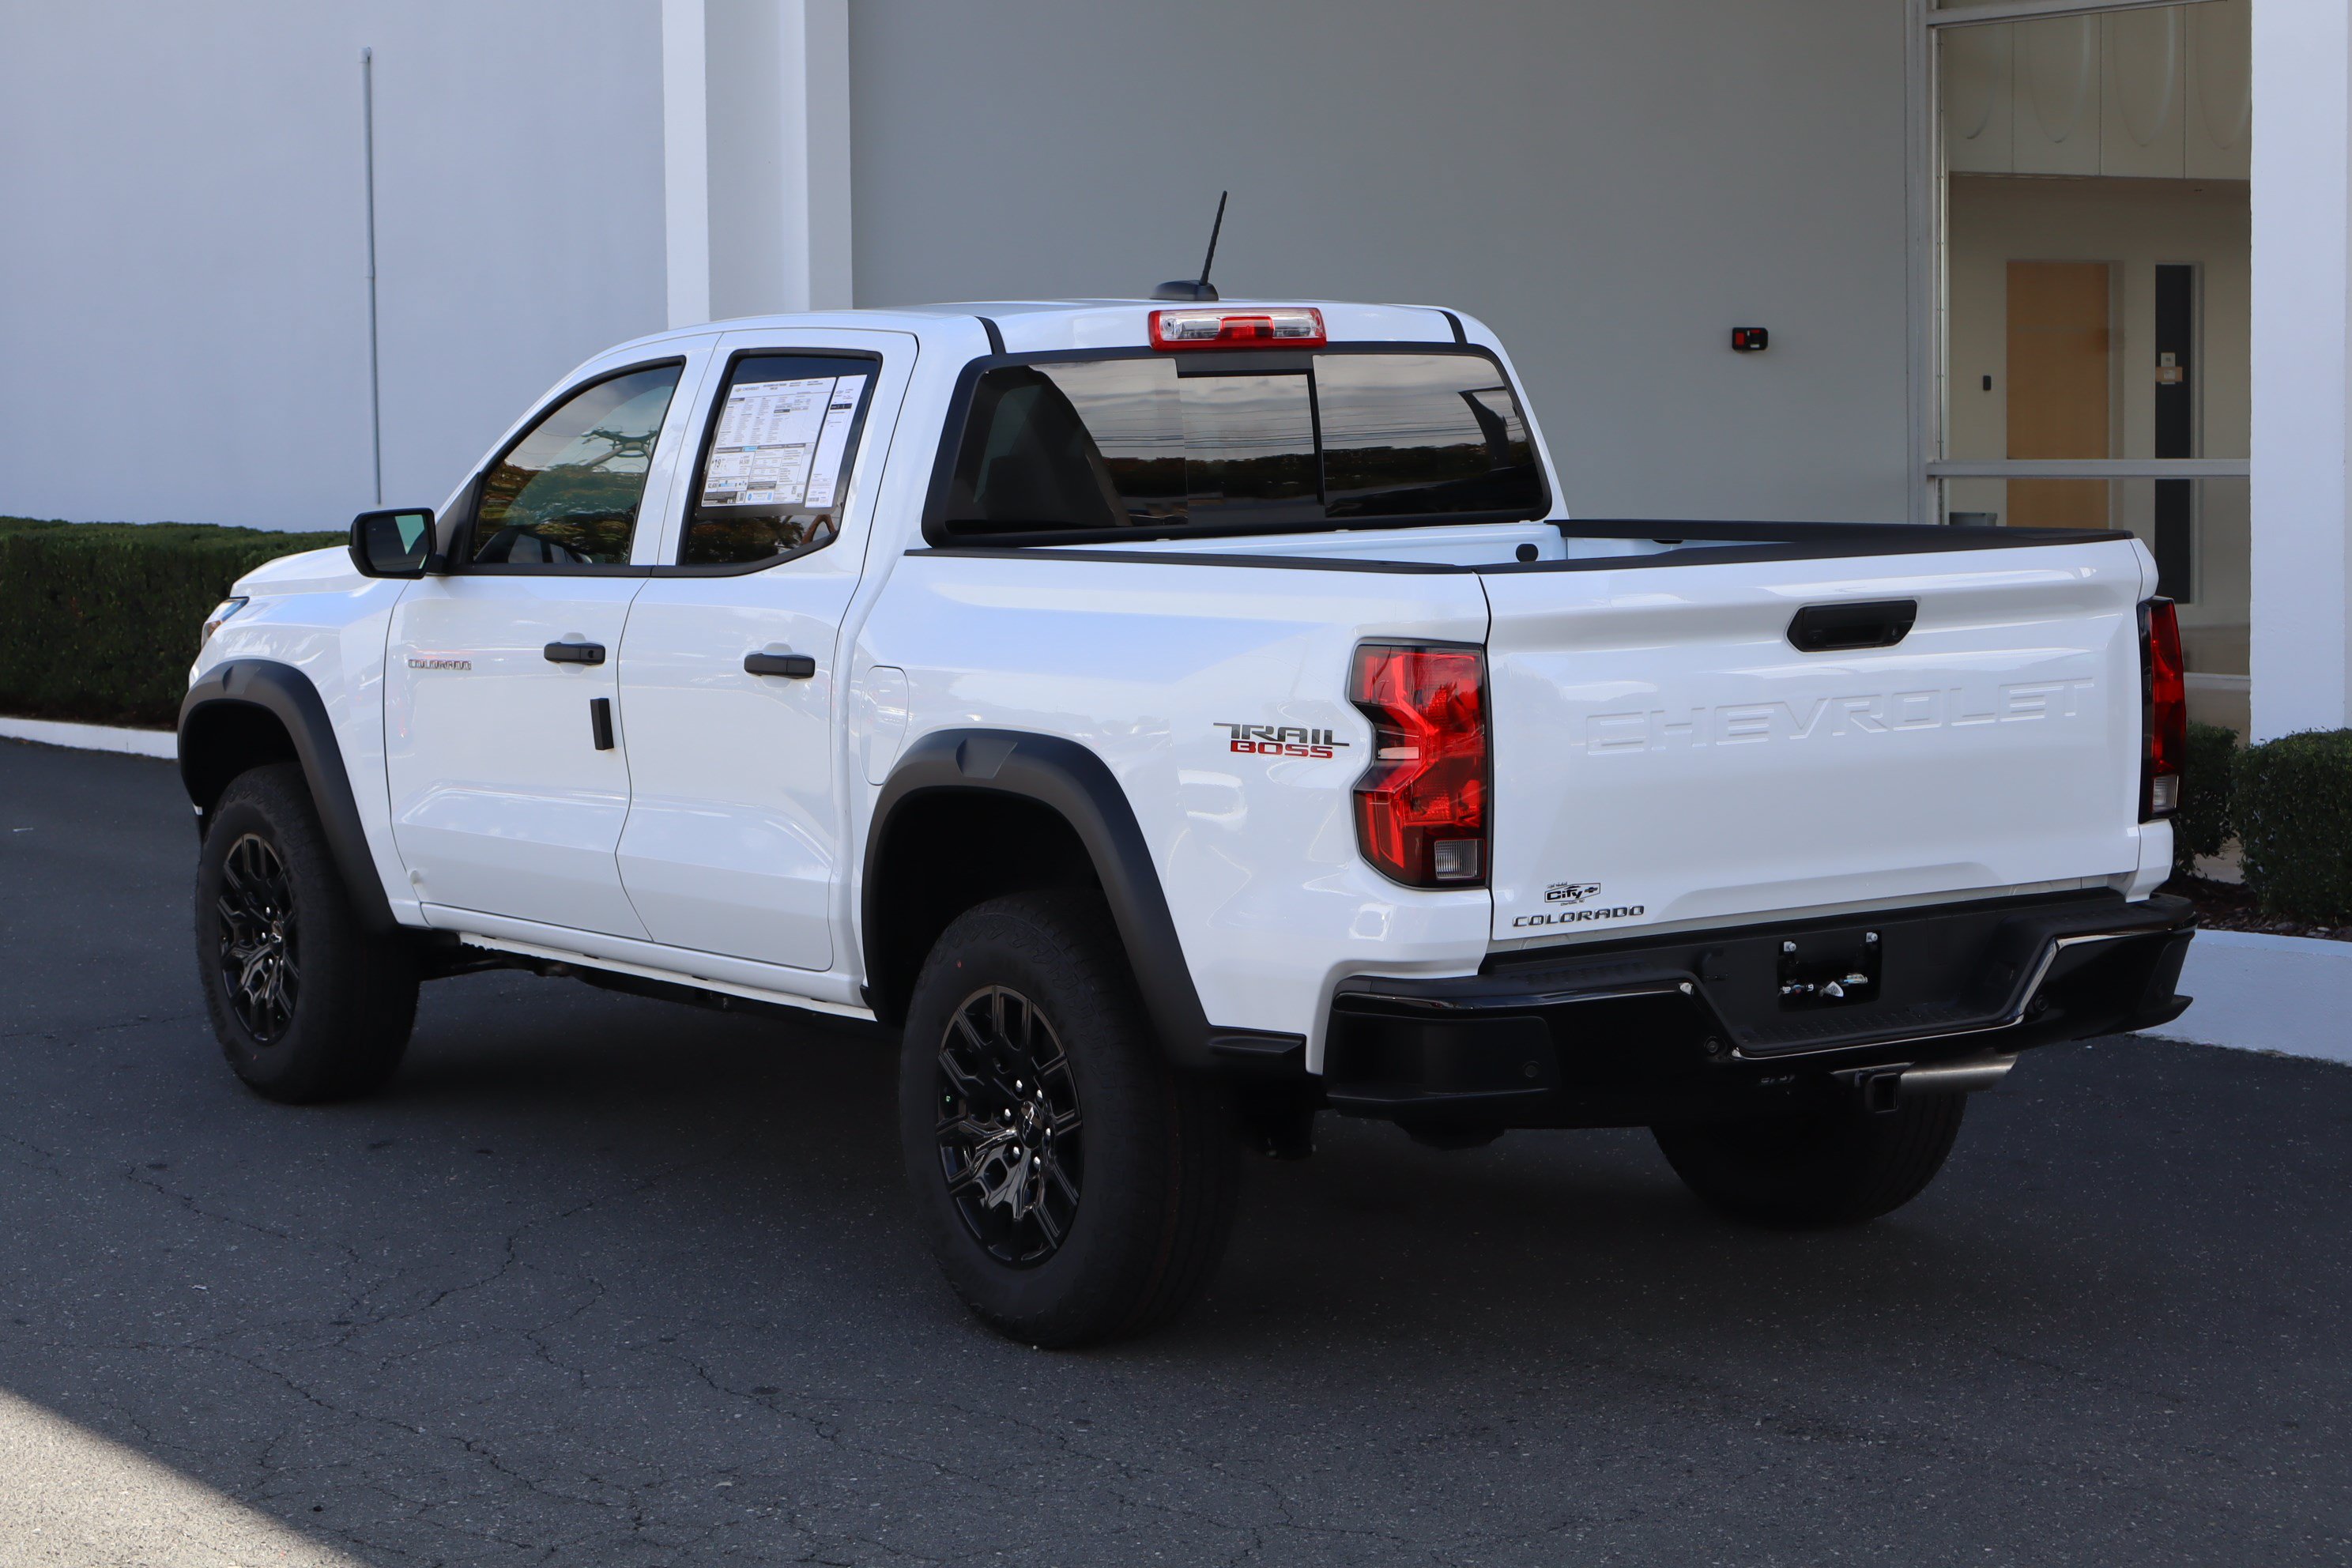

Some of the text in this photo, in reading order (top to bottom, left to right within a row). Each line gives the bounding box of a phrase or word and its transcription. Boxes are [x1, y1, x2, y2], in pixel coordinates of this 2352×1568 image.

[1587, 677, 2094, 756] CHEVROLET
[1213, 722, 1350, 747] TRAIL
[1231, 740, 1333, 759] BOSS
[1547, 888, 1583, 900] City
[1513, 905, 1645, 927] COLORADO
